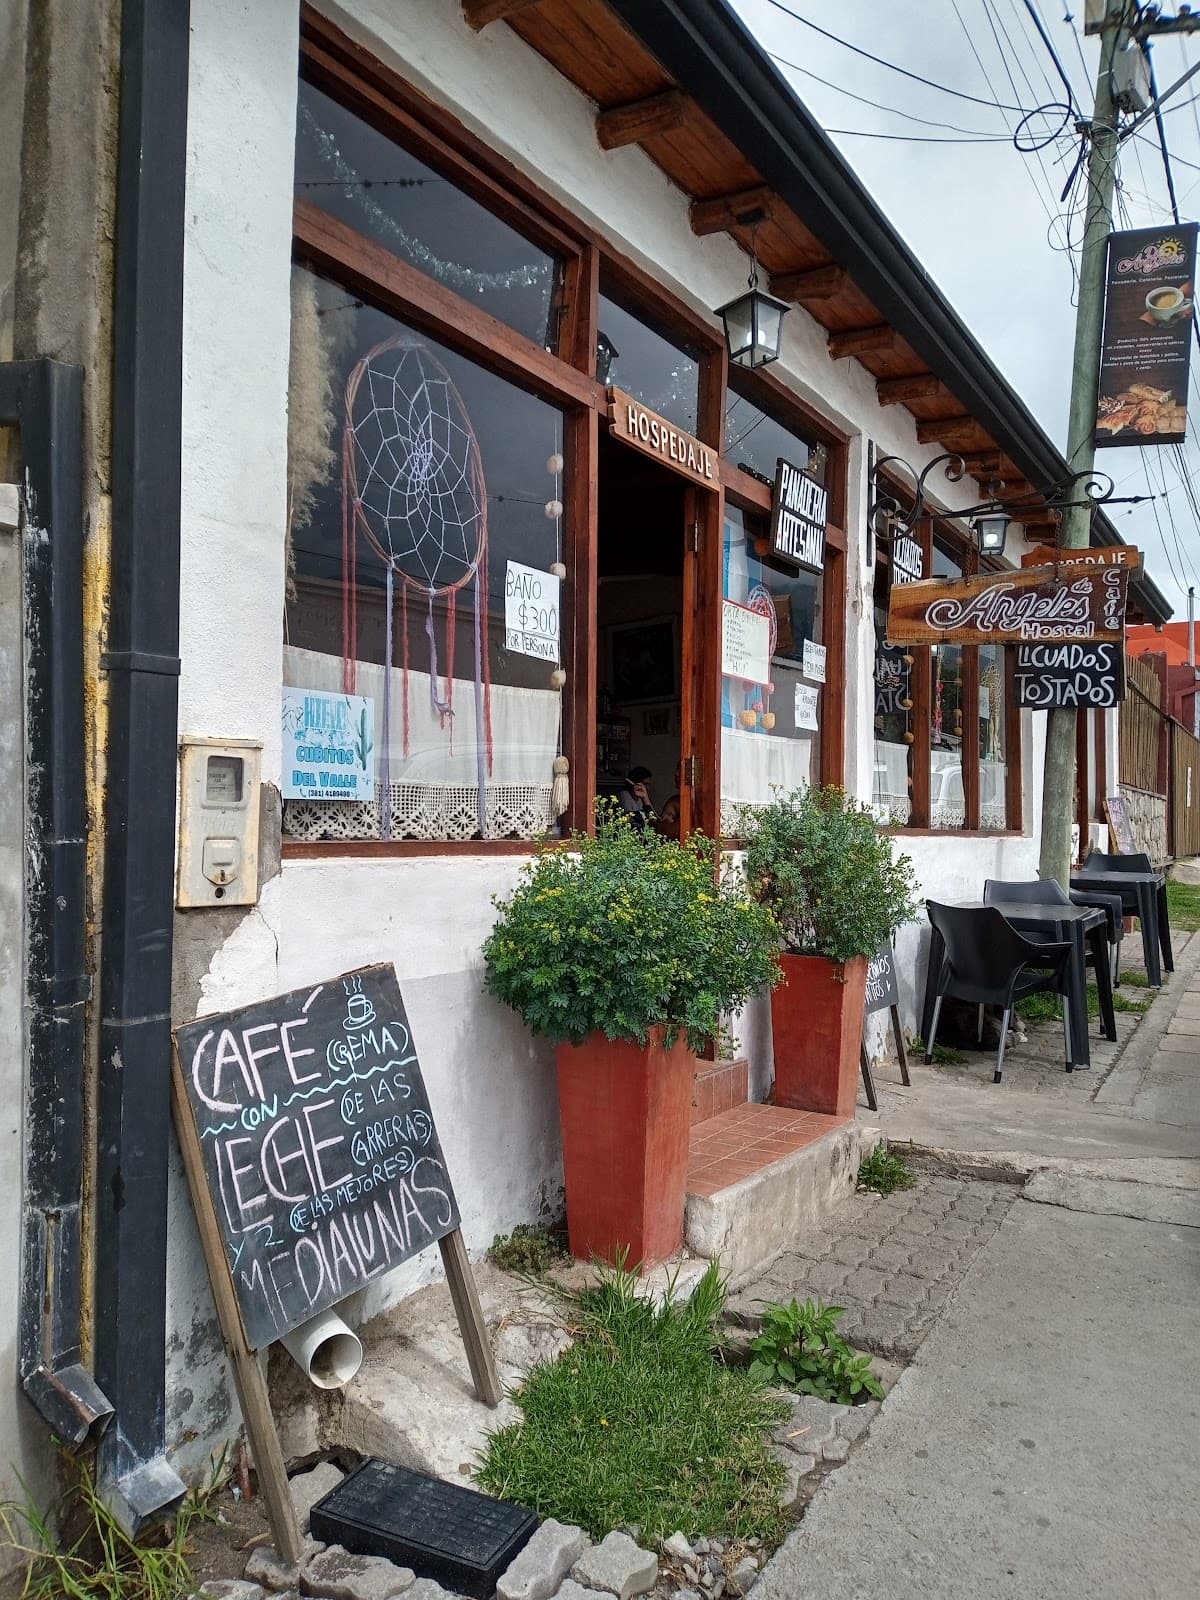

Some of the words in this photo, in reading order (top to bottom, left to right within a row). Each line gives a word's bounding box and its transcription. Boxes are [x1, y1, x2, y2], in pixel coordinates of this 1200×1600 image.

[627, 405, 713, 479] HOSPEDAJE
[779, 462, 828, 528] PANADERIA
[775, 508, 825, 570] ARTESANAL
[506, 568, 542, 600] BAÑO
[1070, 577, 1094, 594] de
[517, 600, 557, 636] $300
[925, 582, 1090, 632] Angeles
[521, 632, 556, 659] PERSONA
[1021, 621, 1095, 639] Hostal
[1017, 643, 1115, 672] LICUADOS
[1013, 672, 1116, 707] TOSTADOS
[295, 745, 355, 766] CUBITOS
[191, 986, 323, 1112] CAFÉ
[326, 1021, 409, 1072] (CREMA)
[371, 1073, 412, 1106] LAS
[240, 1094, 278, 1131] CON
[214, 1099, 354, 1234] LECHE
[310, 1193, 335, 1222] LAS
[335, 1145, 415, 1208] MEJORES)
[254, 1224, 285, 1249] 2
